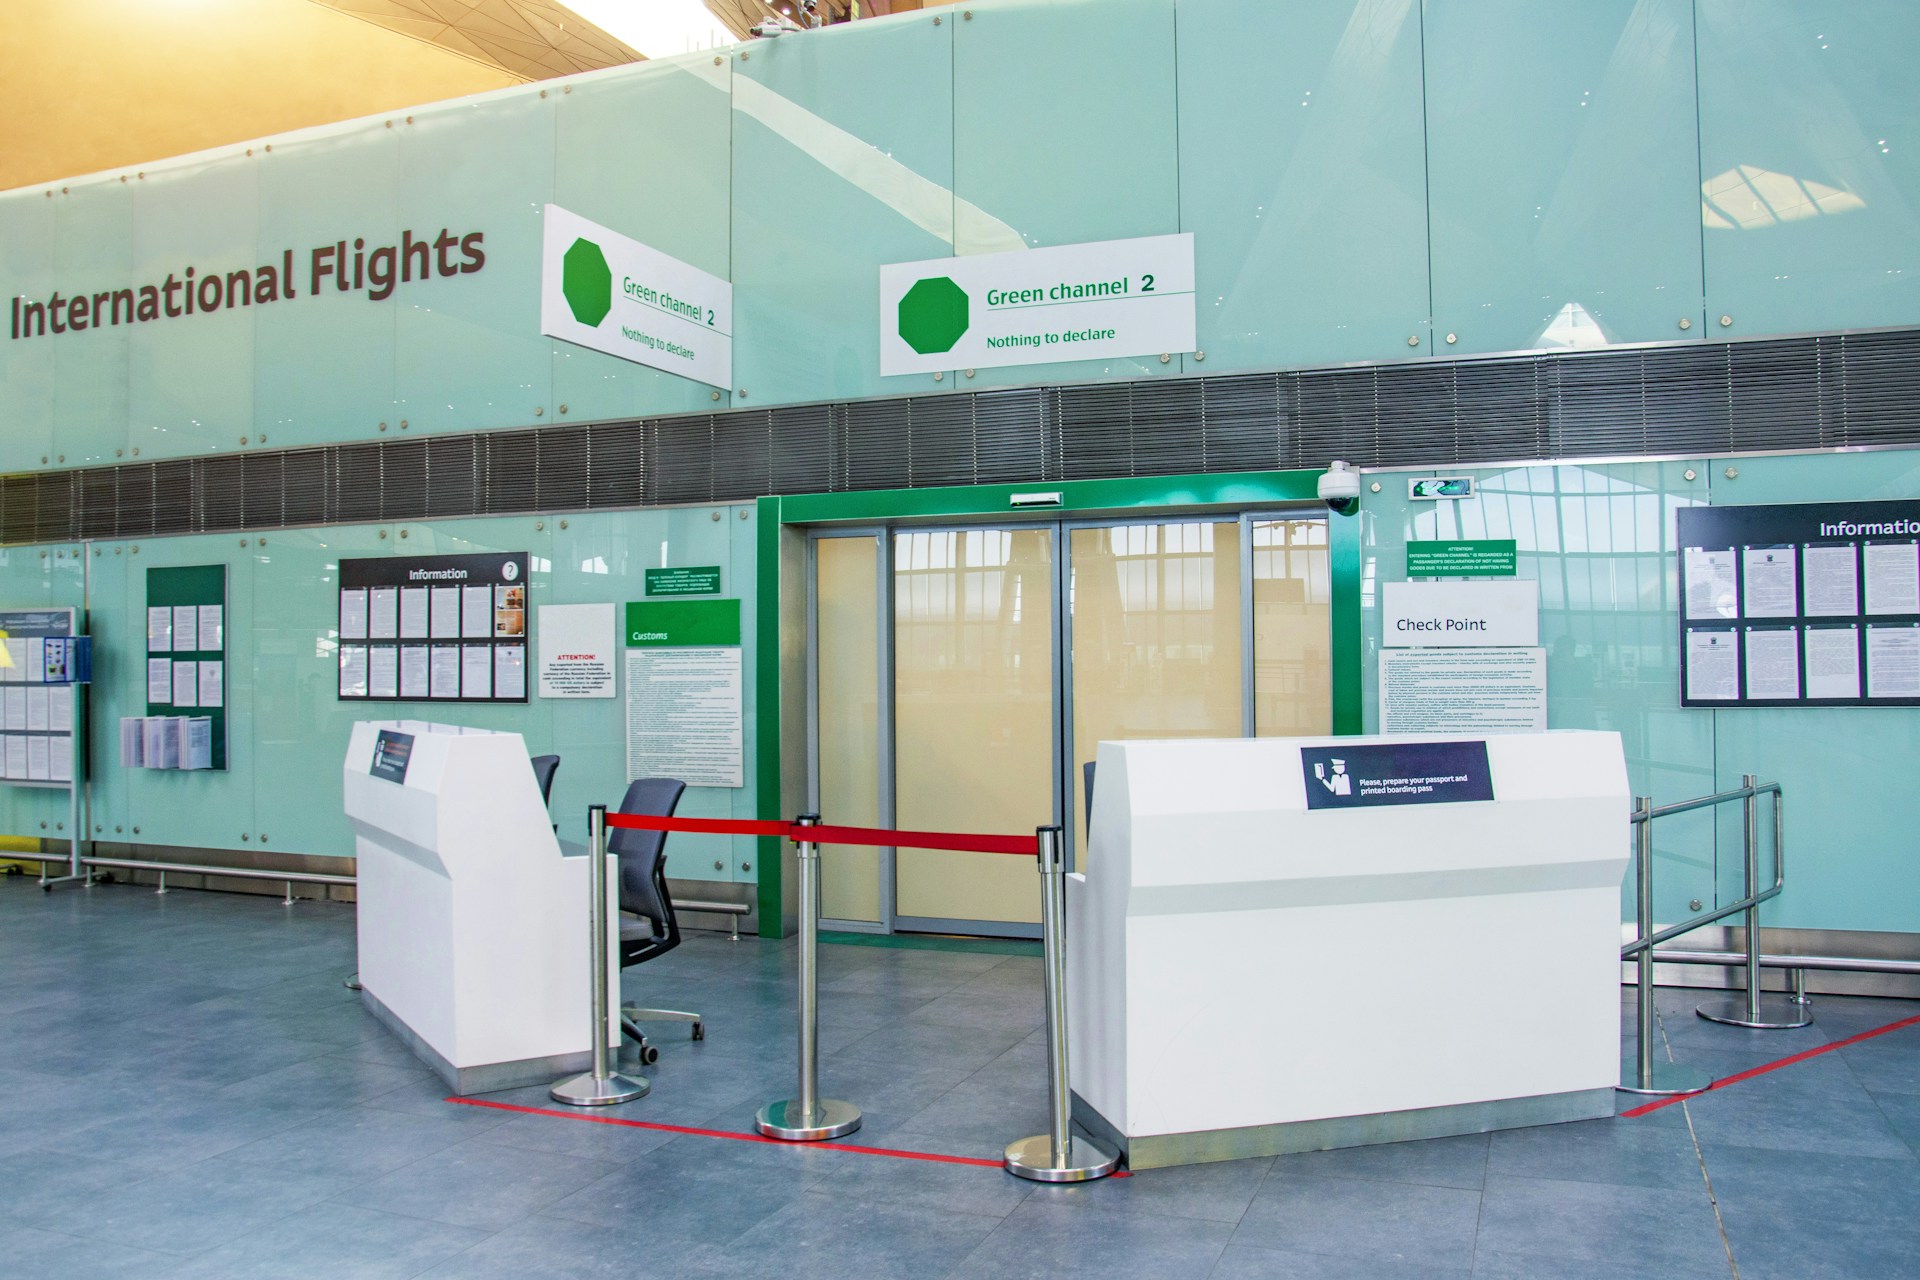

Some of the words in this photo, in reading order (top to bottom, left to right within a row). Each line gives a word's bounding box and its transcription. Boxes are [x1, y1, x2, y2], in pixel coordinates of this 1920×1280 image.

[12, 250, 296, 339] International
[311, 228, 485, 301] Flights
[987, 288, 1044, 306] Green
[1050, 277, 1128, 300] channel
[1141, 274, 1155, 292] 2
[623, 276, 657, 304] Green
[660, 293, 702, 321] channel
[707, 310, 715, 326] 2
[622, 325, 655, 349] Nothing
[656, 338, 665, 350] to
[666, 341, 695, 361] declare
[987, 334, 1041, 349] Nothing
[1045, 332, 1059, 344] to
[1063, 329, 1116, 342] declare
[1820, 518, 1920, 537] Informatio
[409, 568, 468, 580] Information
[1396, 618, 1442, 631] Check
[1446, 618, 1487, 631] Point
[632, 632, 668, 640] Customs
[1425, 775, 1454, 784] passport
[1361, 786, 1386, 796] printed
[1386, 786, 1417, 794] boarding
